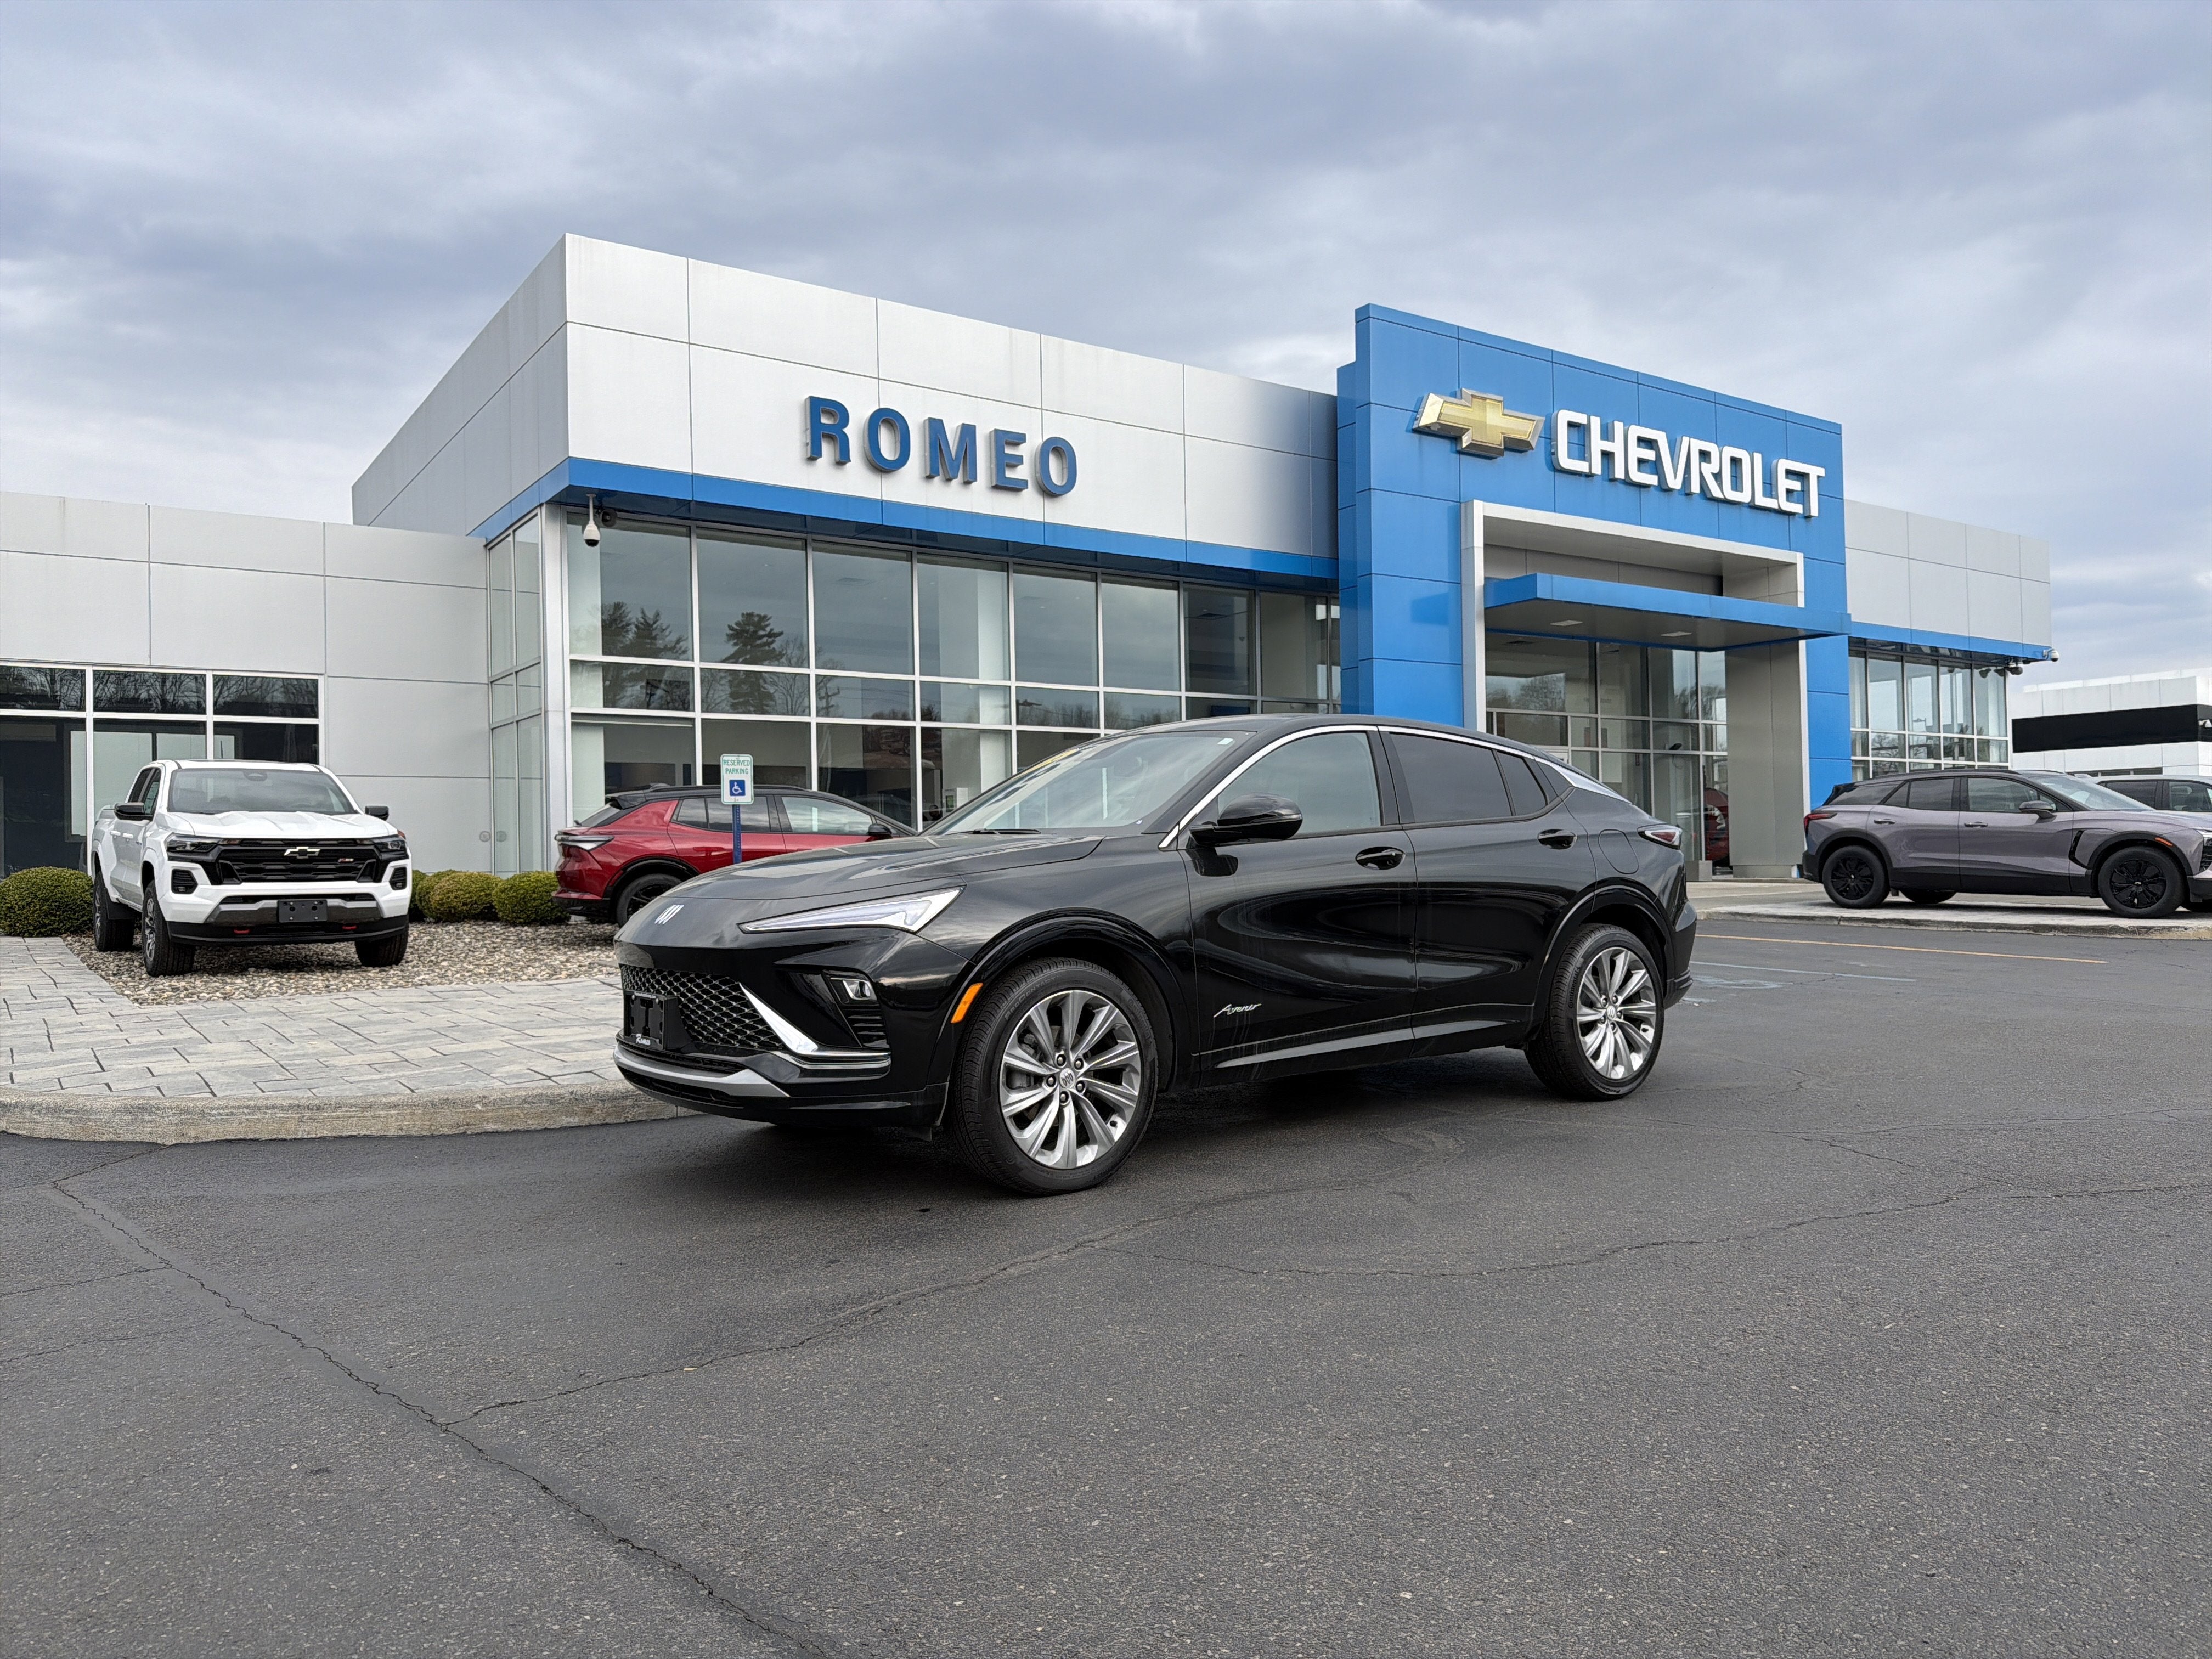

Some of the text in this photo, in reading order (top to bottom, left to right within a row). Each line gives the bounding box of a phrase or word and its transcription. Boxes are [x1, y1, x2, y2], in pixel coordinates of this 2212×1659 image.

[805, 396, 1077, 496] ROMEO
[1551, 409, 1825, 518] CHEVROLET
[1213, 1003, 1262, 1018] Avenir
